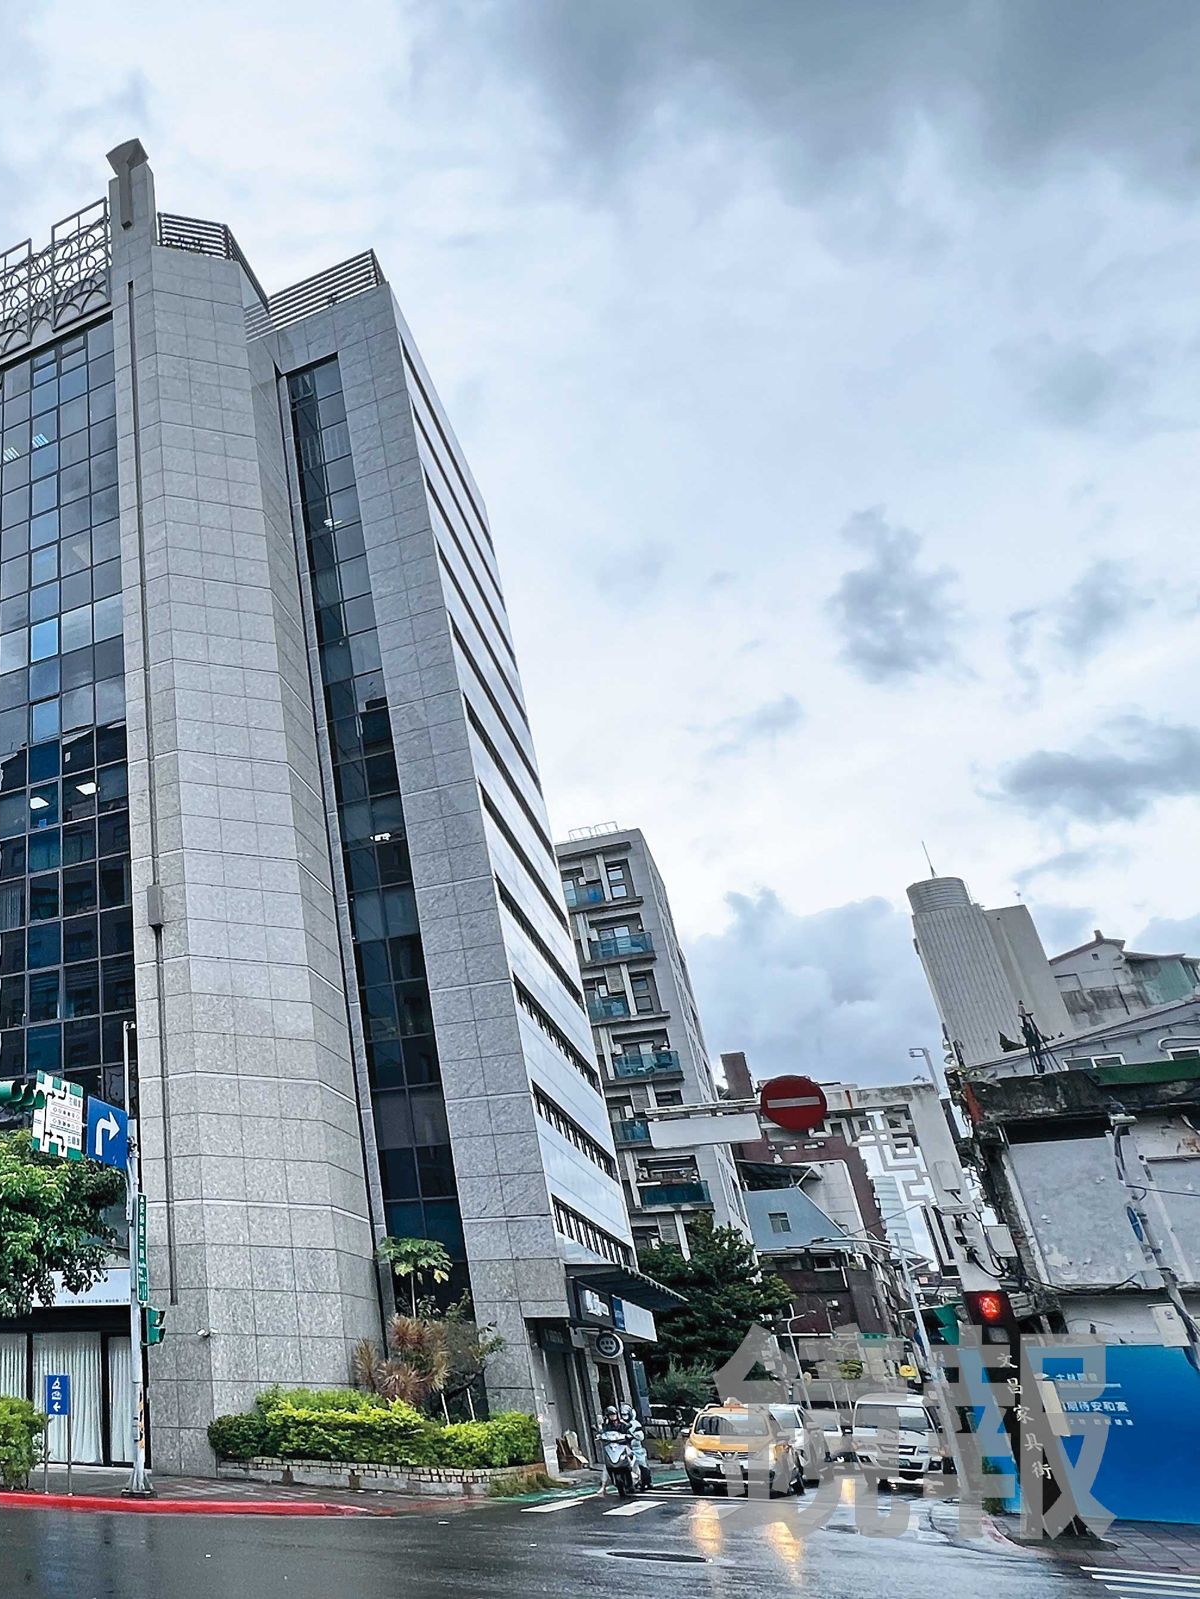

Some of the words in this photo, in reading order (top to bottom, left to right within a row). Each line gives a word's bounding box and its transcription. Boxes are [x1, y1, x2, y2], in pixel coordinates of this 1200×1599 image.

[997, 1352, 1052, 1480] 文昌家具街
